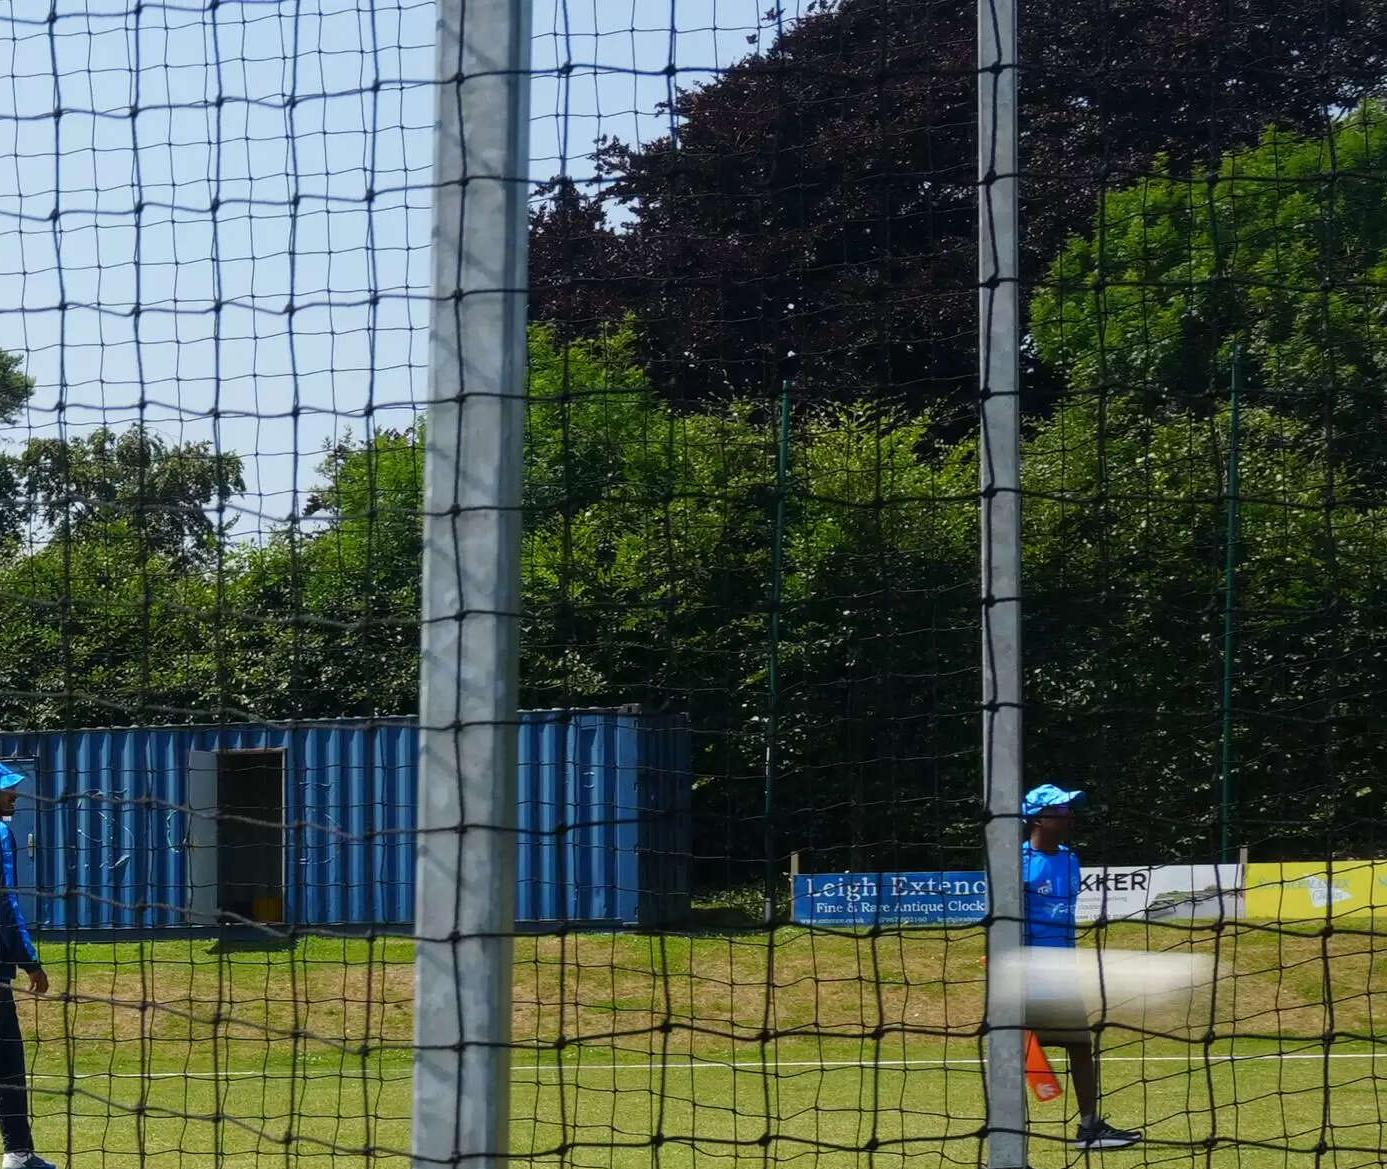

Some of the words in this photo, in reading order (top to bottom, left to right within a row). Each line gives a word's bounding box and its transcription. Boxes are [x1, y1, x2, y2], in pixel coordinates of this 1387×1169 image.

[806, 876, 878, 902] Leigh
[815, 902, 844, 914] Fine
[893, 900, 945, 915] Antique
